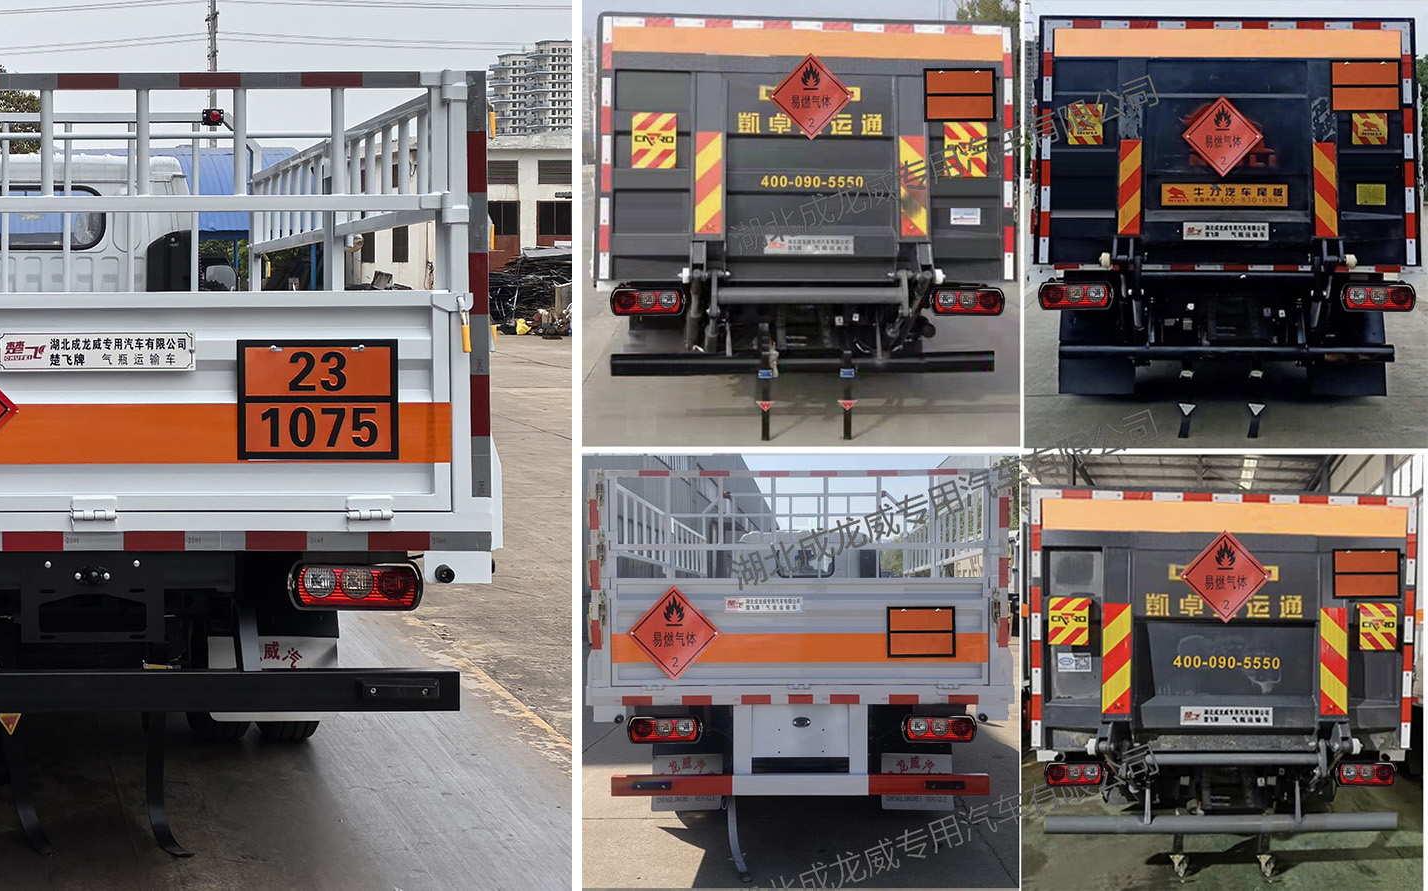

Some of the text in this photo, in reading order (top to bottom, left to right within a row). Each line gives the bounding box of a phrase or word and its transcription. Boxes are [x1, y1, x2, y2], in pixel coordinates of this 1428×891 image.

[791, 95, 831, 109] 易燃气体
[808, 118, 815, 127] 2
[1206, 136, 1241, 147] 易燃气体
[1221, 157, 1227, 165] 2
[761, 175, 864, 188] 400-090-5550
[49, 338, 187, 350] 湖北成龙威专用汽车有限公司
[49, 353, 176, 366] 楚飞牌 气瓶运输车
[289, 351, 347, 391] 23
[261, 407, 378, 447] 1075
[1204, 575, 1248, 590] 易燃气体
[1223, 600, 1230, 610] 2
[653, 631, 696, 647] 易燃气体
[672, 657, 678, 667] 2
[1173, 655, 1281, 669] 400-090-5550
